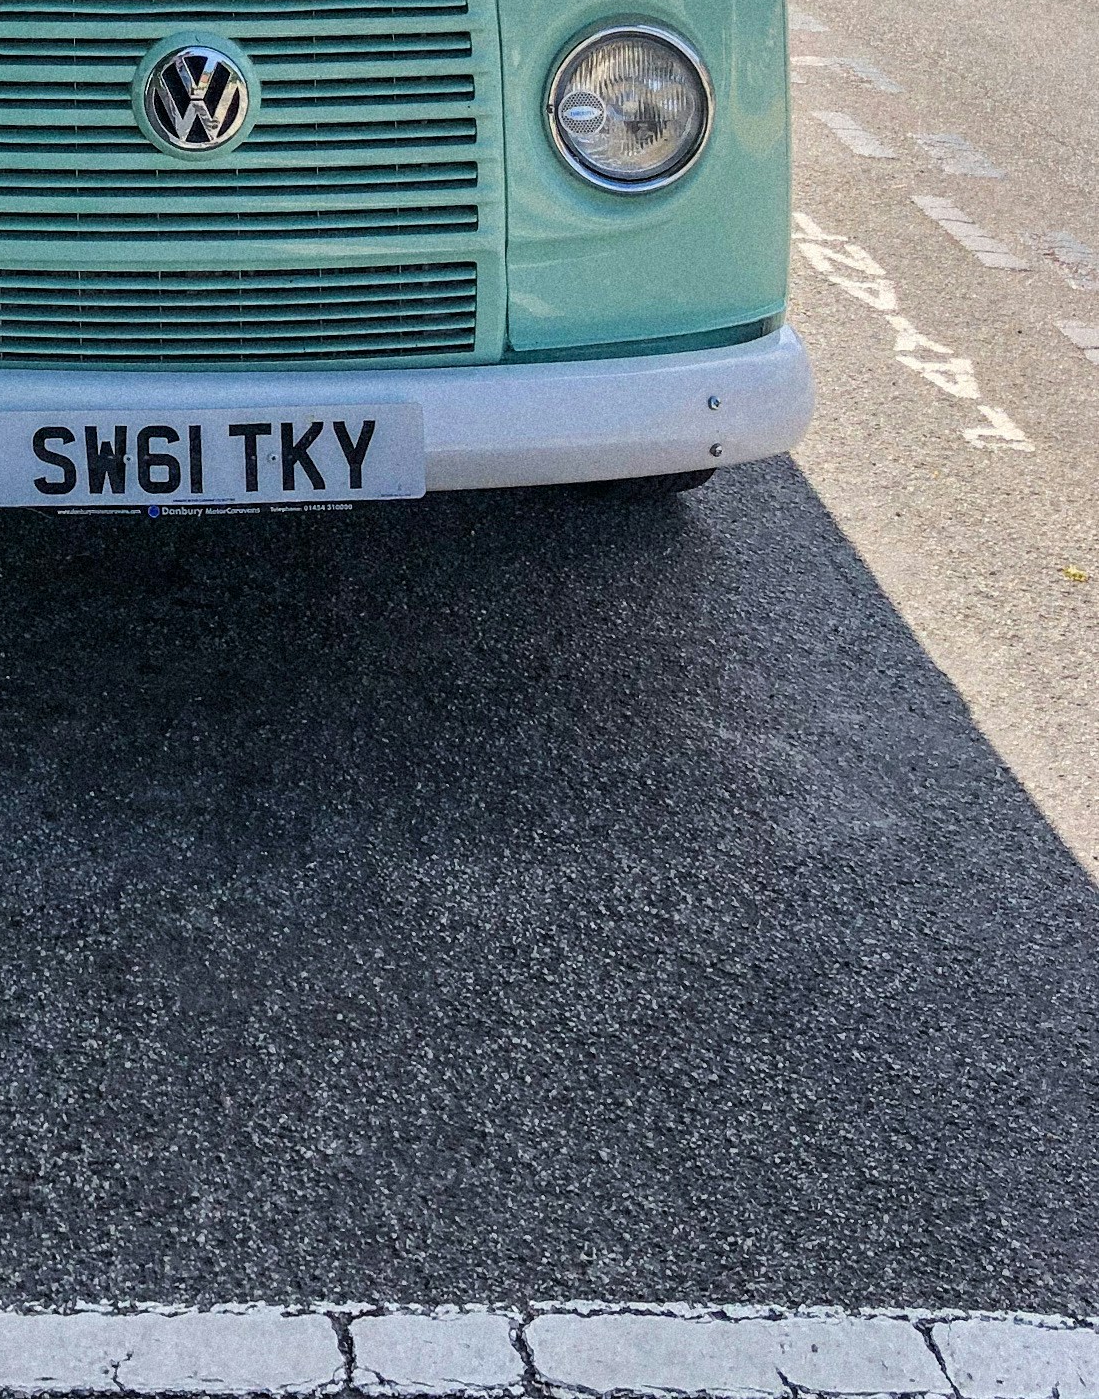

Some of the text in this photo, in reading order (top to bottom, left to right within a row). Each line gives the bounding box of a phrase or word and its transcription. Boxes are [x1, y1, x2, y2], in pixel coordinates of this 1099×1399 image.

[32, 419, 376, 495] SW61 TKY
[161, 506, 203, 517] Danbury
